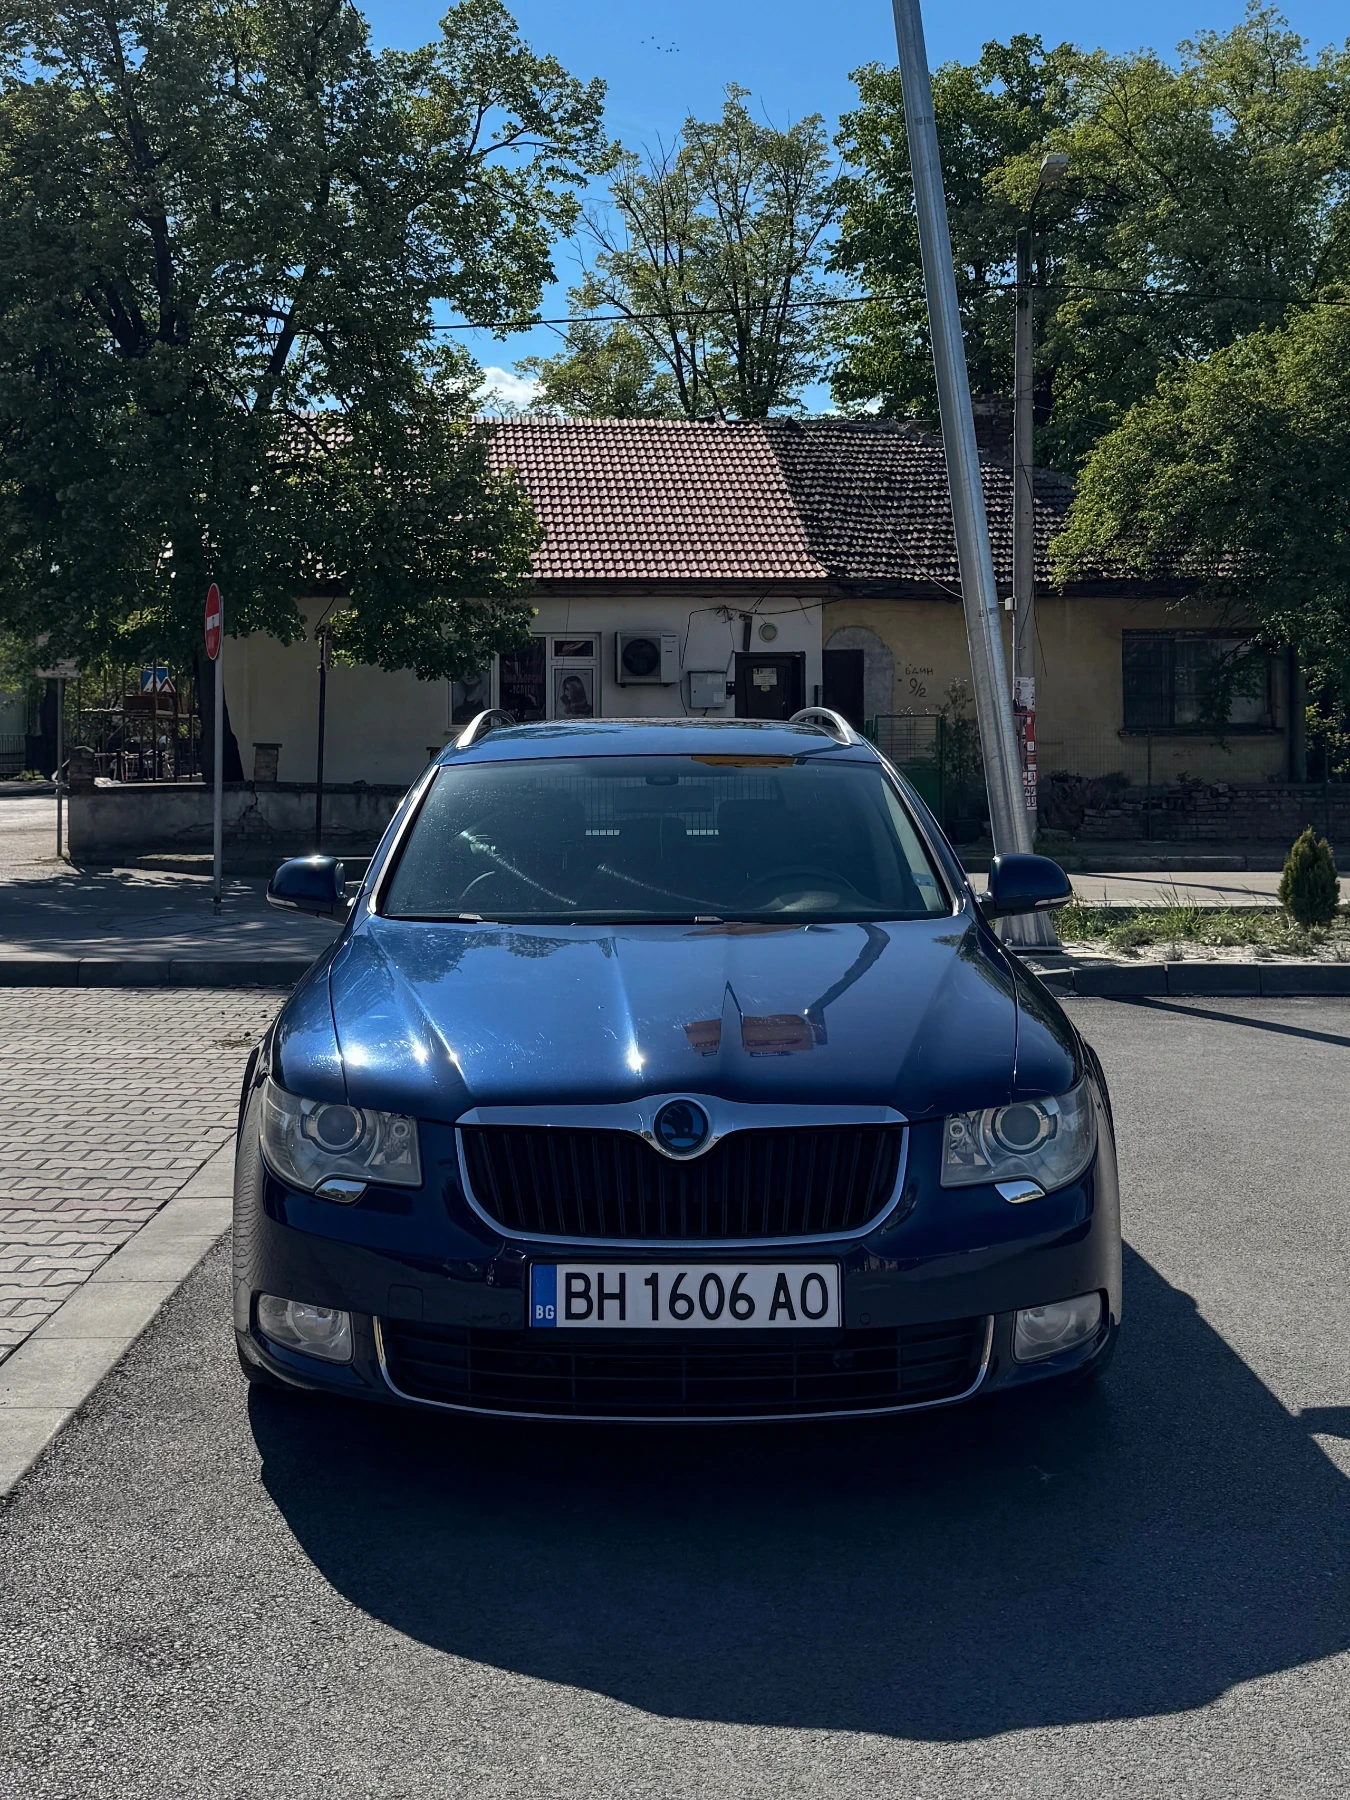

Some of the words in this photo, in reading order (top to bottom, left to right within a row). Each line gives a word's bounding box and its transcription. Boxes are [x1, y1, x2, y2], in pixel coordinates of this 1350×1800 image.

[908, 677, 927, 698] 9/2
[564, 1272, 626, 1321] BH
[644, 1272, 755, 1321] 1606
[768, 1272, 829, 1321] AO
[535, 1304, 555, 1320] BG
